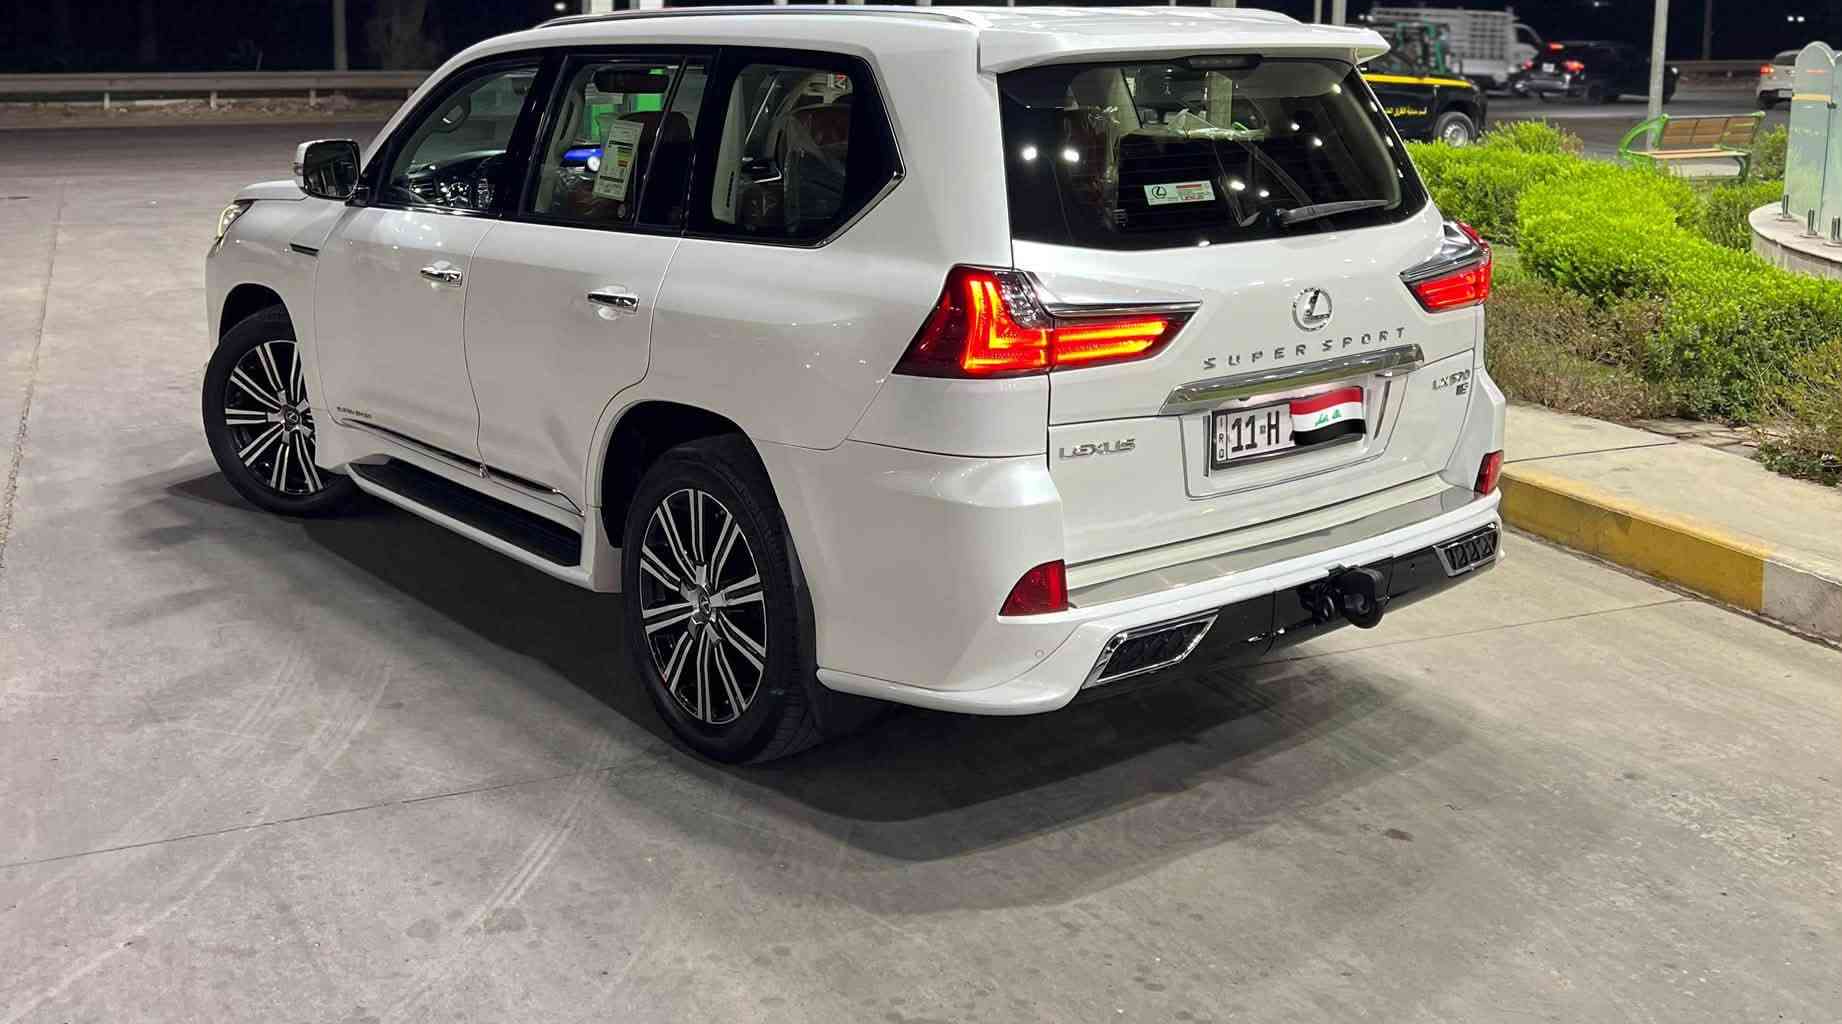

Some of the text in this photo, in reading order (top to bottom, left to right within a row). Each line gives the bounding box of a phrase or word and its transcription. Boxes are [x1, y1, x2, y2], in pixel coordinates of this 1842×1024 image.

[1203, 327, 1405, 370] SUPER SPORT
[1059, 438, 1136, 458] LEXUS
